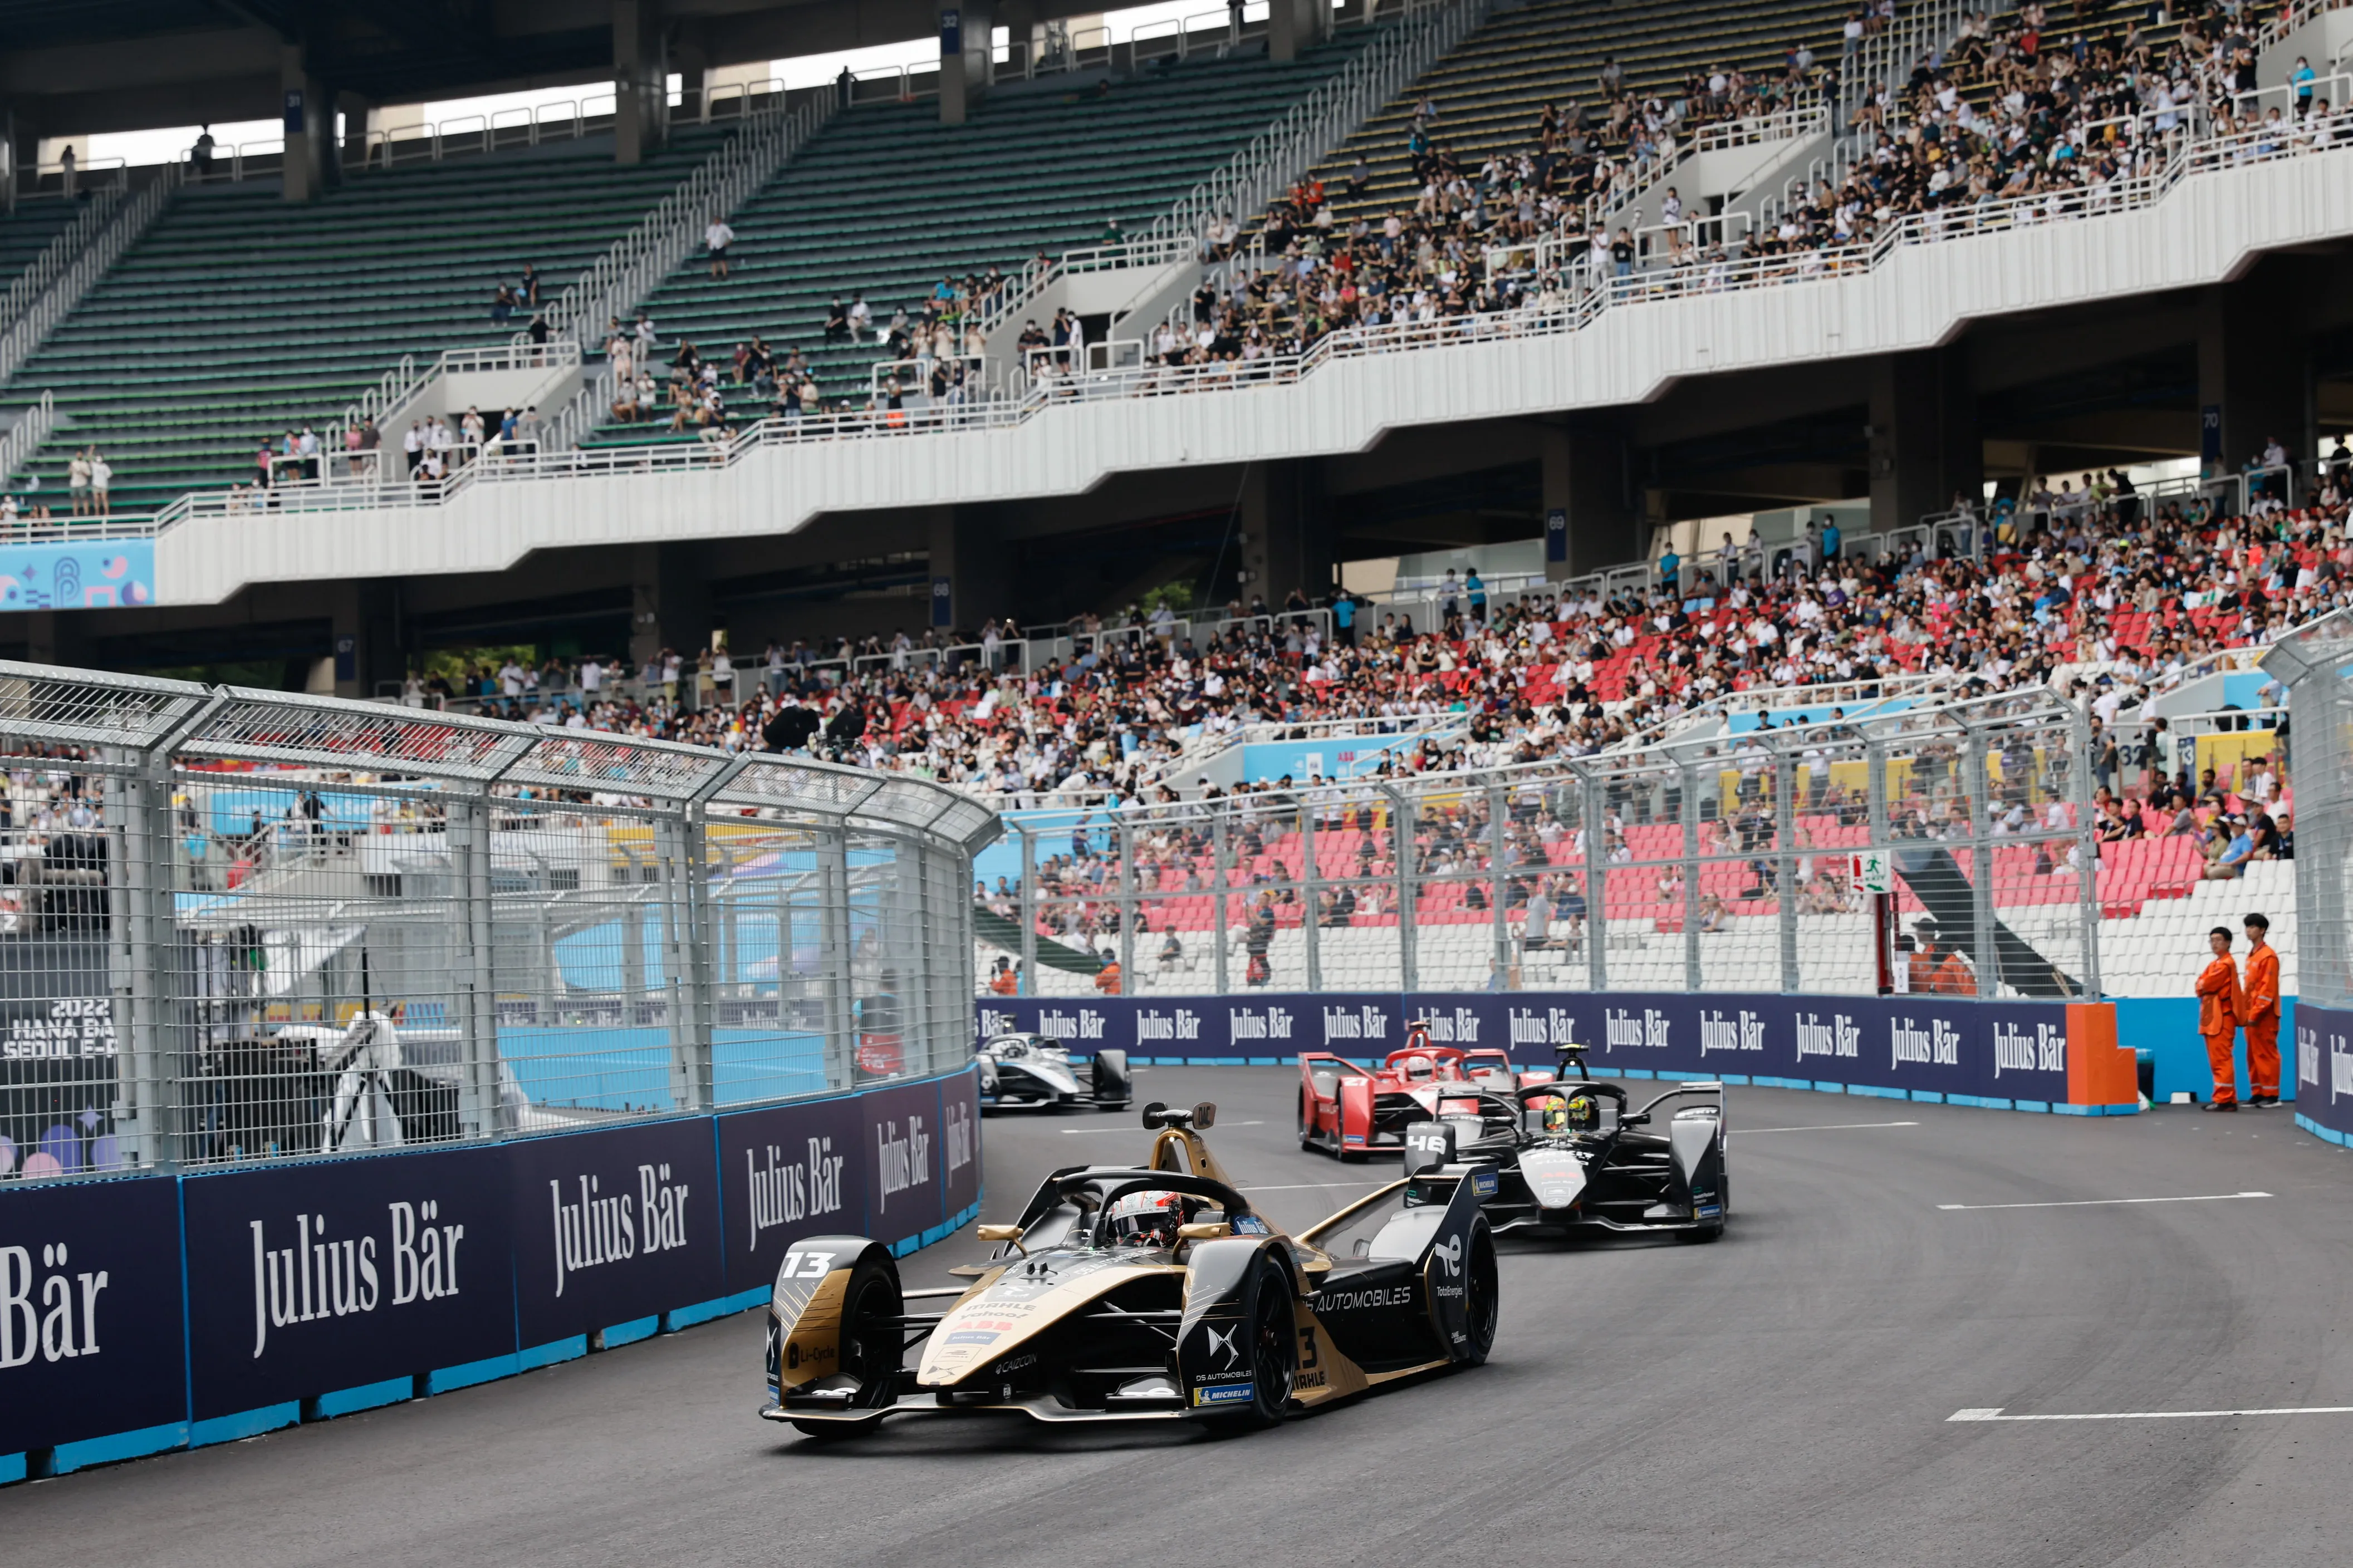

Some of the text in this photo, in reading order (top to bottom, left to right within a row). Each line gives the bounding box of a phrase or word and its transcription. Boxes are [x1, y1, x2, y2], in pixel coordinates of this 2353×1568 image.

[2203, 412, 2219, 429] 70
[1549, 515, 1565, 530] 69
[1337, 751, 1355, 761] ABB
[51, 999, 110, 1018] 2022
[13, 1019, 79, 1040] HANA
[1079, 1009, 1106, 1039] Bär
[1136, 1009, 1200, 1046] Julius Bär
[1230, 1007, 1293, 1046] Julius Bär
[1323, 1005, 1388, 1045] Julius Bär
[1455, 1007, 1480, 1042] Bär
[1509, 1007, 1575, 1050] Julius Bär
[1605, 1008, 1670, 1054] Julius Bär
[1700, 1010, 1765, 1058] Julius Bär
[1796, 1012, 1861, 1063] Julius Bär
[3, 1040, 76, 1061] SEOUL
[1891, 1016, 1960, 1070] Julius Bär
[1993, 1022, 2066, 1079] Julius Bär
[1344, 1077, 1370, 1087] 27
[1407, 1135, 1448, 1155] 48
[877, 1116, 929, 1214] Julius Bär
[746, 1137, 844, 1252] Julius Bär
[550, 1163, 689, 1298] Julius Bär
[1236, 1220, 1258, 1235] Julius
[250, 1200, 464, 1358] Julius Bär
[782, 1252, 836, 1279] 13
[1316, 1286, 1411, 1313] AUTOMOBILES
[1437, 1285, 1463, 1298] TotalEnergies
[0, 1243, 108, 1369] Bär
[959, 1310, 1029, 1320] yahoo!
[965, 1302, 1037, 1311] MAHLE
[950, 1320, 1013, 1331] ABB
[800, 1345, 835, 1363] Li-Cycle
[1002, 1353, 1038, 1373] CAIZCOIN
[1207, 1370, 1252, 1380] AUTOMOBILES
[1211, 1389, 1251, 1400] MICHELIN
